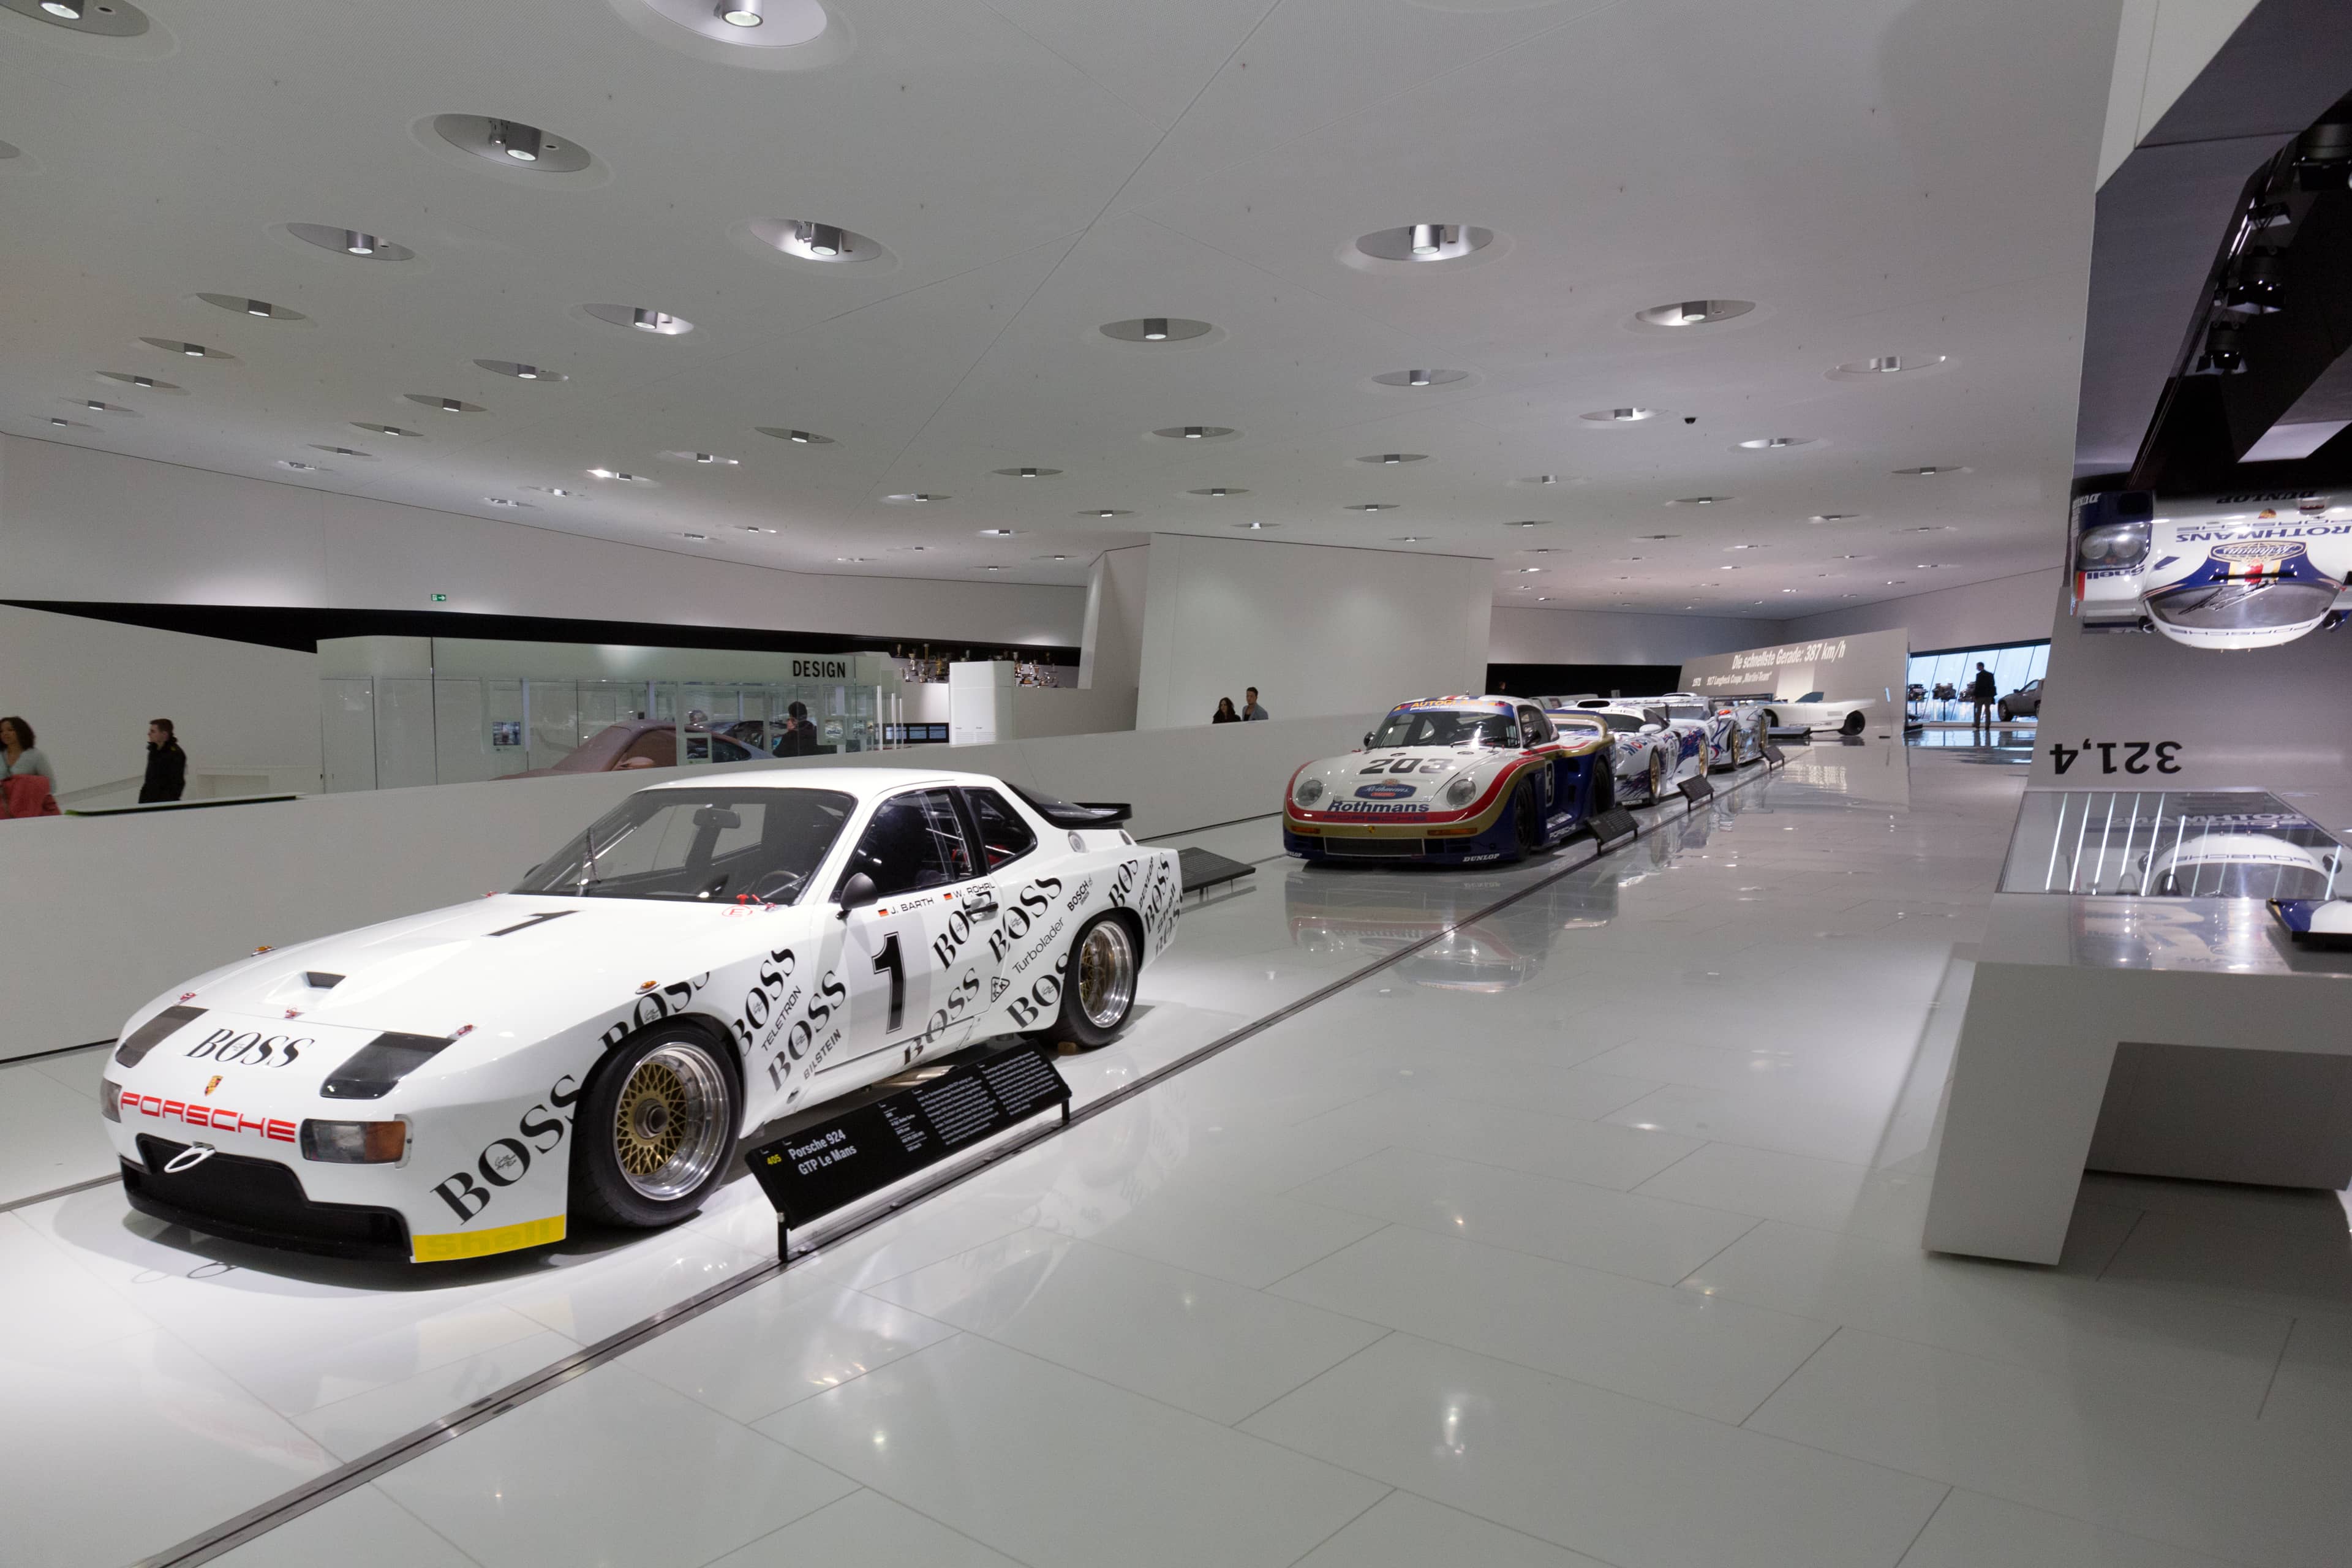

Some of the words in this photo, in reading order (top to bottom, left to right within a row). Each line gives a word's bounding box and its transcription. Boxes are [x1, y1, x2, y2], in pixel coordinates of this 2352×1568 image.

[2216, 491, 2315, 504] DUNLOP
[2176, 526, 2352, 543] ROTHMANS
[793, 660, 845, 678] DESIGN
[1732, 654, 1743, 669] Die
[1743, 650, 1775, 668] schnellste
[1776, 646, 1804, 665] Gerade:
[1804, 643, 1822, 662] 387
[1822, 640, 1846, 663] km/h
[1359, 758, 1453, 774] 203
[2049, 738, 2182, 775] 321,4
[1327, 801, 1430, 813] Rothmans
[1463, 853, 1500, 862] DUNLOP
[891, 906, 899, 914] J.
[900, 897, 934, 912] BARTH
[1067, 880, 1089, 911] BOSCH
[1144, 852, 1170, 935] BOSS
[987, 877, 1062, 966] BOSS
[1012, 917, 1063, 973] Turbolader
[872, 931, 907, 1035] 1
[731, 949, 795, 1057] BOSS
[761, 986, 802, 1051] TELETRON
[904, 967, 979, 1065] BOSS
[183, 1028, 315, 1068] BOSS
[766, 970, 846, 1092] BOSS
[804, 1029, 842, 1080] BILSTEIN
[121, 1091, 296, 1143] PORSCHE
[430, 1074, 581, 1226] BOSS
[767, 1154, 782, 1166] 405
[788, 1137, 828, 1160] Porsche
[826, 1129, 846, 1144] 924
[798, 1159, 818, 1175] GTP
[820, 1154, 833, 1167] Le
[833, 1145, 857, 1163] Mans
